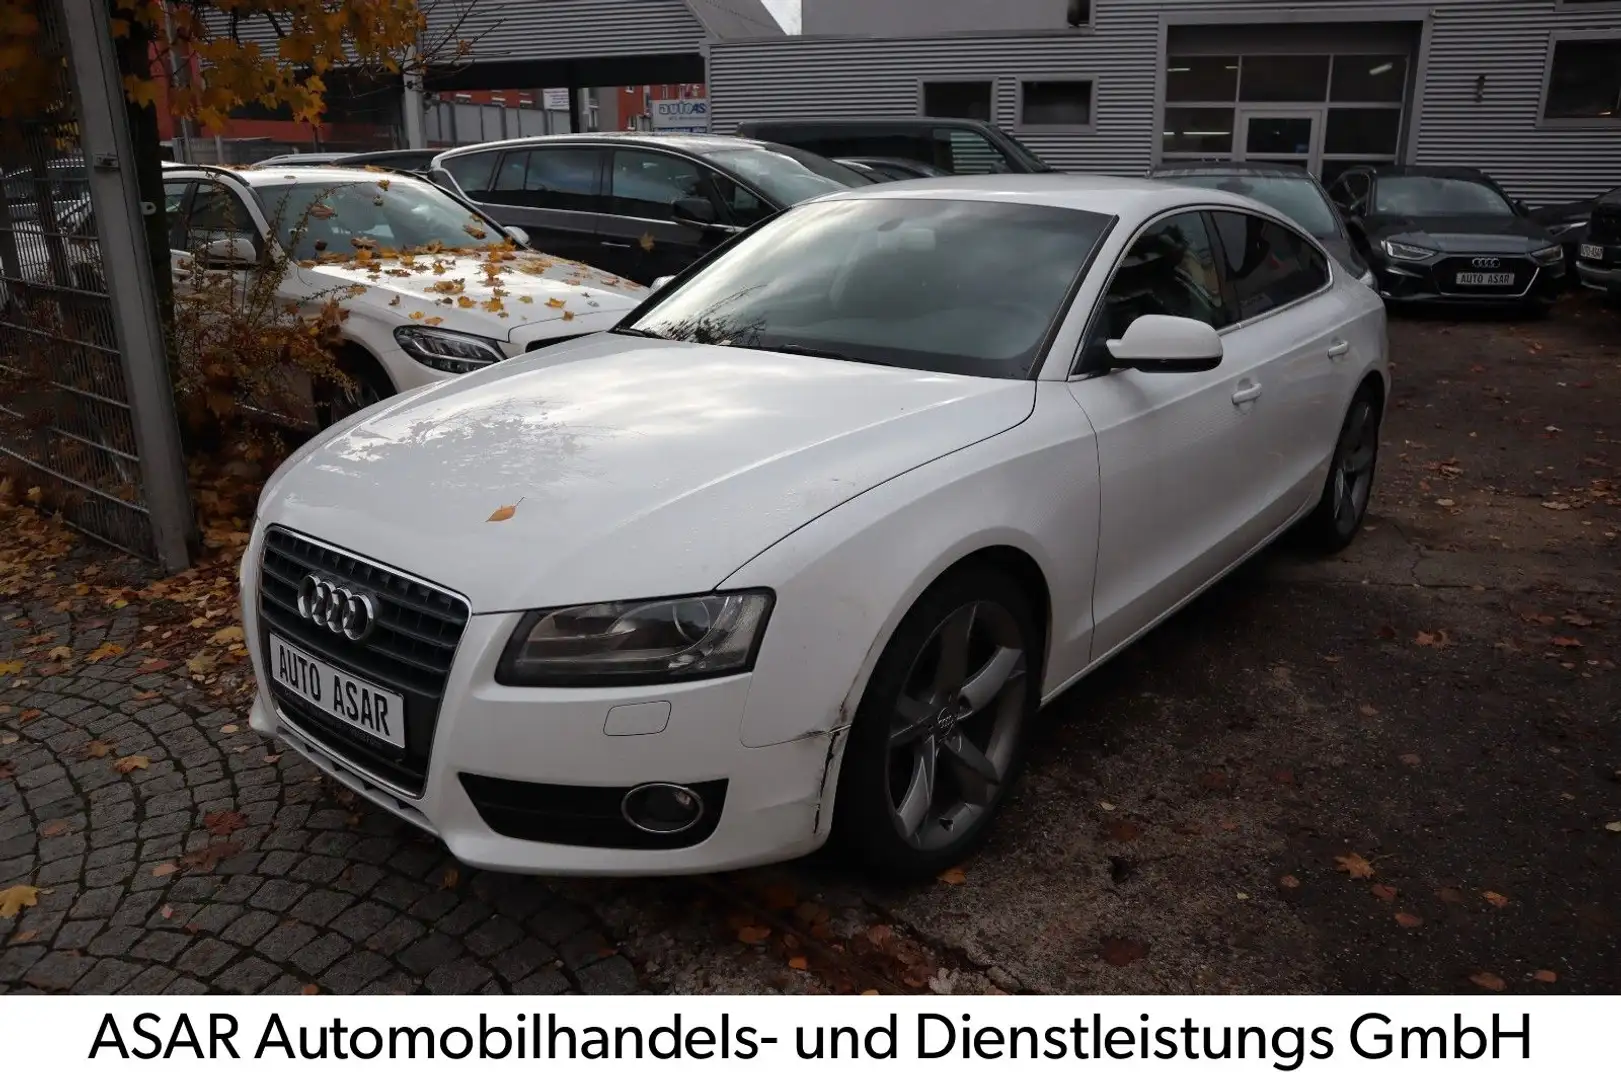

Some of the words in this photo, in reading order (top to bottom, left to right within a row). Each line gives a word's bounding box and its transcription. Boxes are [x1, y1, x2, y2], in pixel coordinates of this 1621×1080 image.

[1460, 273, 1483, 284] AUTO
[1488, 274, 1510, 284] ASAR
[279, 644, 321, 702] AUTO
[333, 674, 390, 737] ASAR
